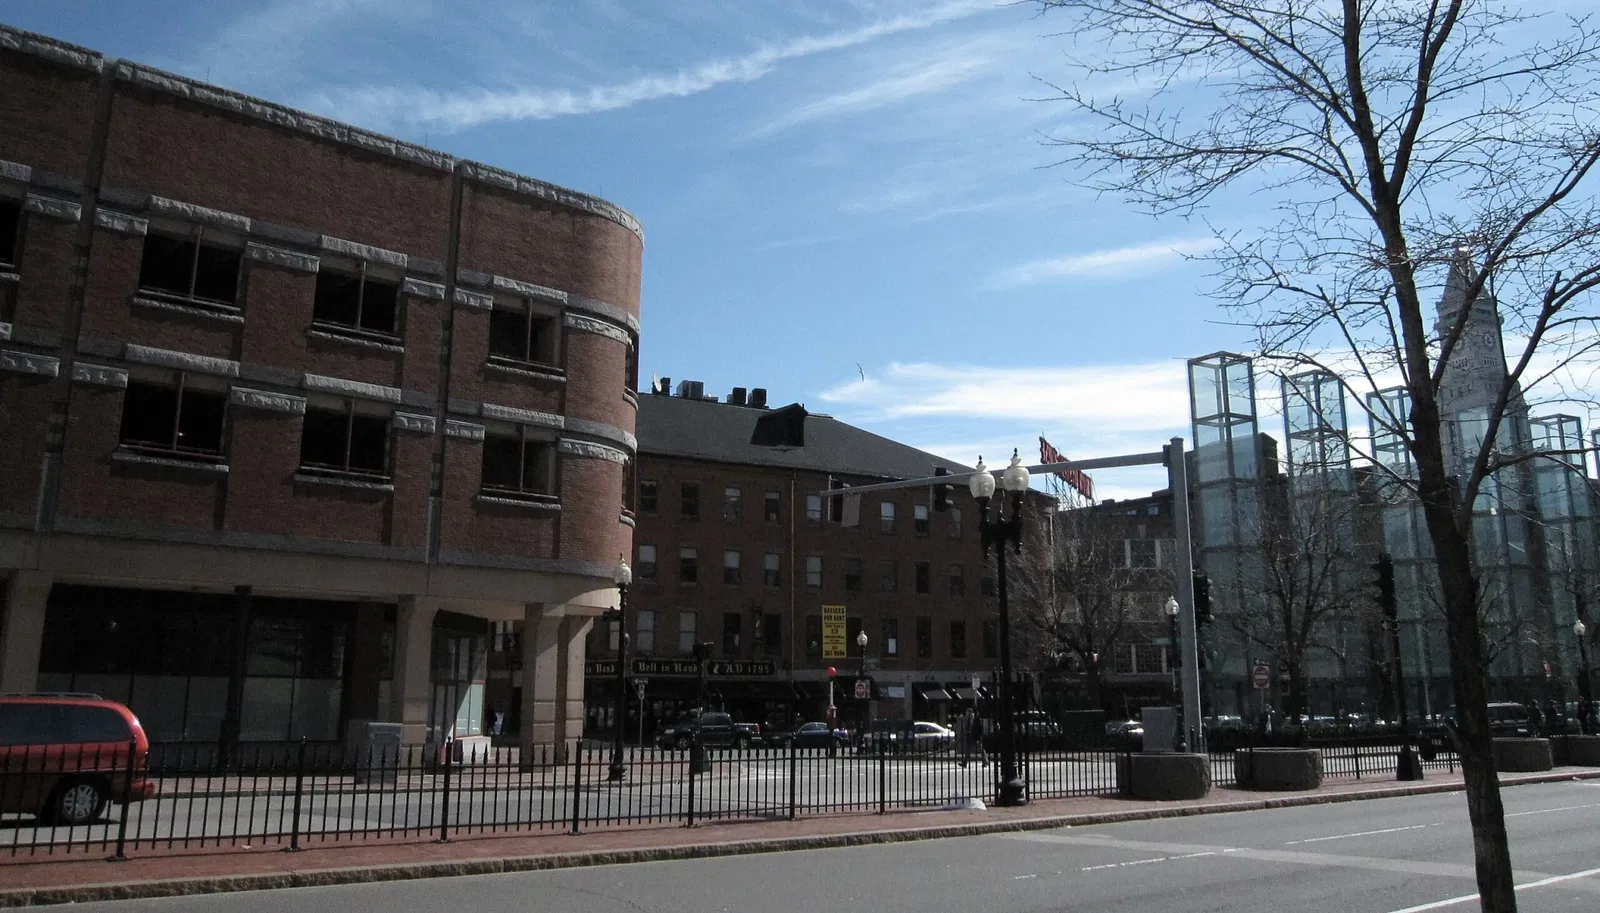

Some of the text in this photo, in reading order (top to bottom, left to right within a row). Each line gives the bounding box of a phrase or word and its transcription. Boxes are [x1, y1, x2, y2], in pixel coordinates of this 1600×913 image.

[638, 662, 698, 673] Bell in Hand
[748, 664, 769, 674] 1795
